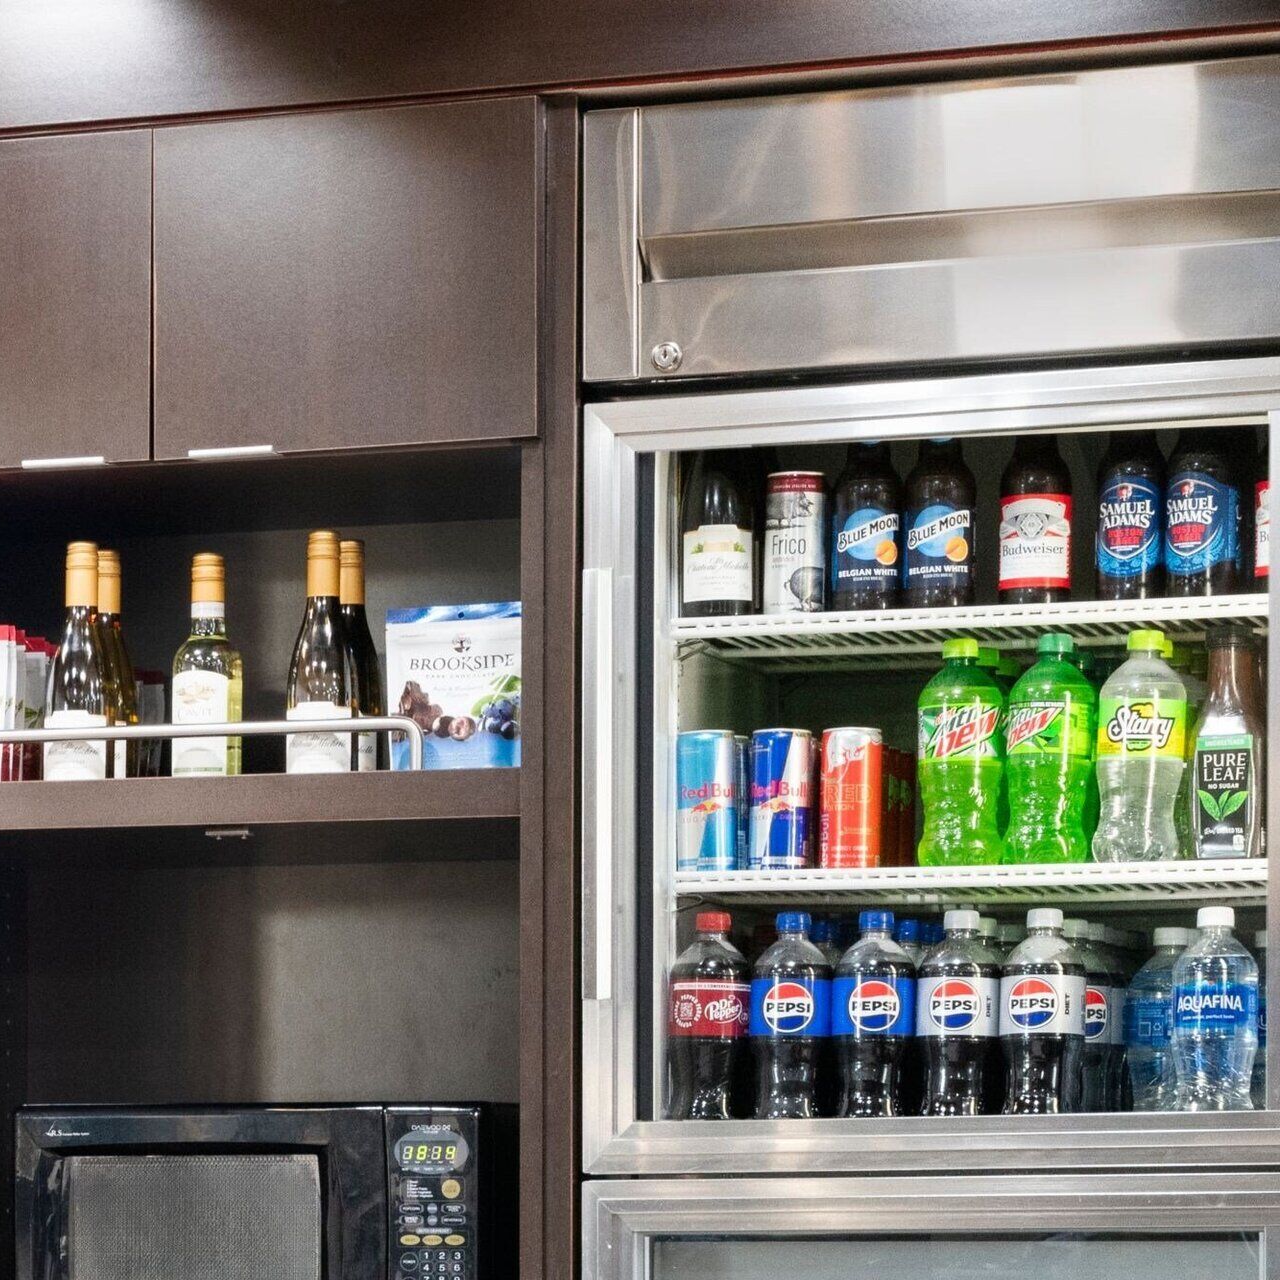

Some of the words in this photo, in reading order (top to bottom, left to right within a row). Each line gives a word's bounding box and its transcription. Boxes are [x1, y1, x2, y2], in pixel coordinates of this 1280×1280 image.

[1098, 498, 1155, 519] SAMUEL
[1166, 494, 1218, 513] SAMUEL
[1102, 512, 1152, 530] ADAMS
[1167, 507, 1215, 526] ADAMS
[837, 527, 869, 551] BLUE
[868, 515, 899, 537] MOON
[908, 523, 938, 550] BLUE
[938, 512, 969, 534] MOON
[771, 534, 807, 556] Frico
[1001, 543, 1065, 558] Budweiser
[838, 567, 873, 578] BELGIAN
[873, 566, 898, 577] WHITE
[908, 565, 944, 576] BELGIAN
[944, 564, 969, 575] WHITE
[409, 652, 515, 672] BROOKSIDE
[1106, 705, 1176, 750] Starry
[1203, 752, 1247, 767] PURE
[779, 780, 808, 798] Bull
[825, 783, 873, 800] RED
[1218, 782, 1240, 790] SUGAR
[705, 1001, 742, 1023] Pepper
[765, 1002, 811, 1014] PEPSI
[851, 1000, 897, 1013] PEPSI
[932, 999, 978, 1012] PEPSI
[1010, 997, 1056, 1010] PEPSI
[1176, 994, 1245, 1013] AQUAFINA
[438, 1251, 446, 1260] 2
[454, 1251, 462, 1260] 3
[423, 1263, 430, 1272] 4
[438, 1263, 446, 1272] 5
[453, 1263, 461, 1272] 6
